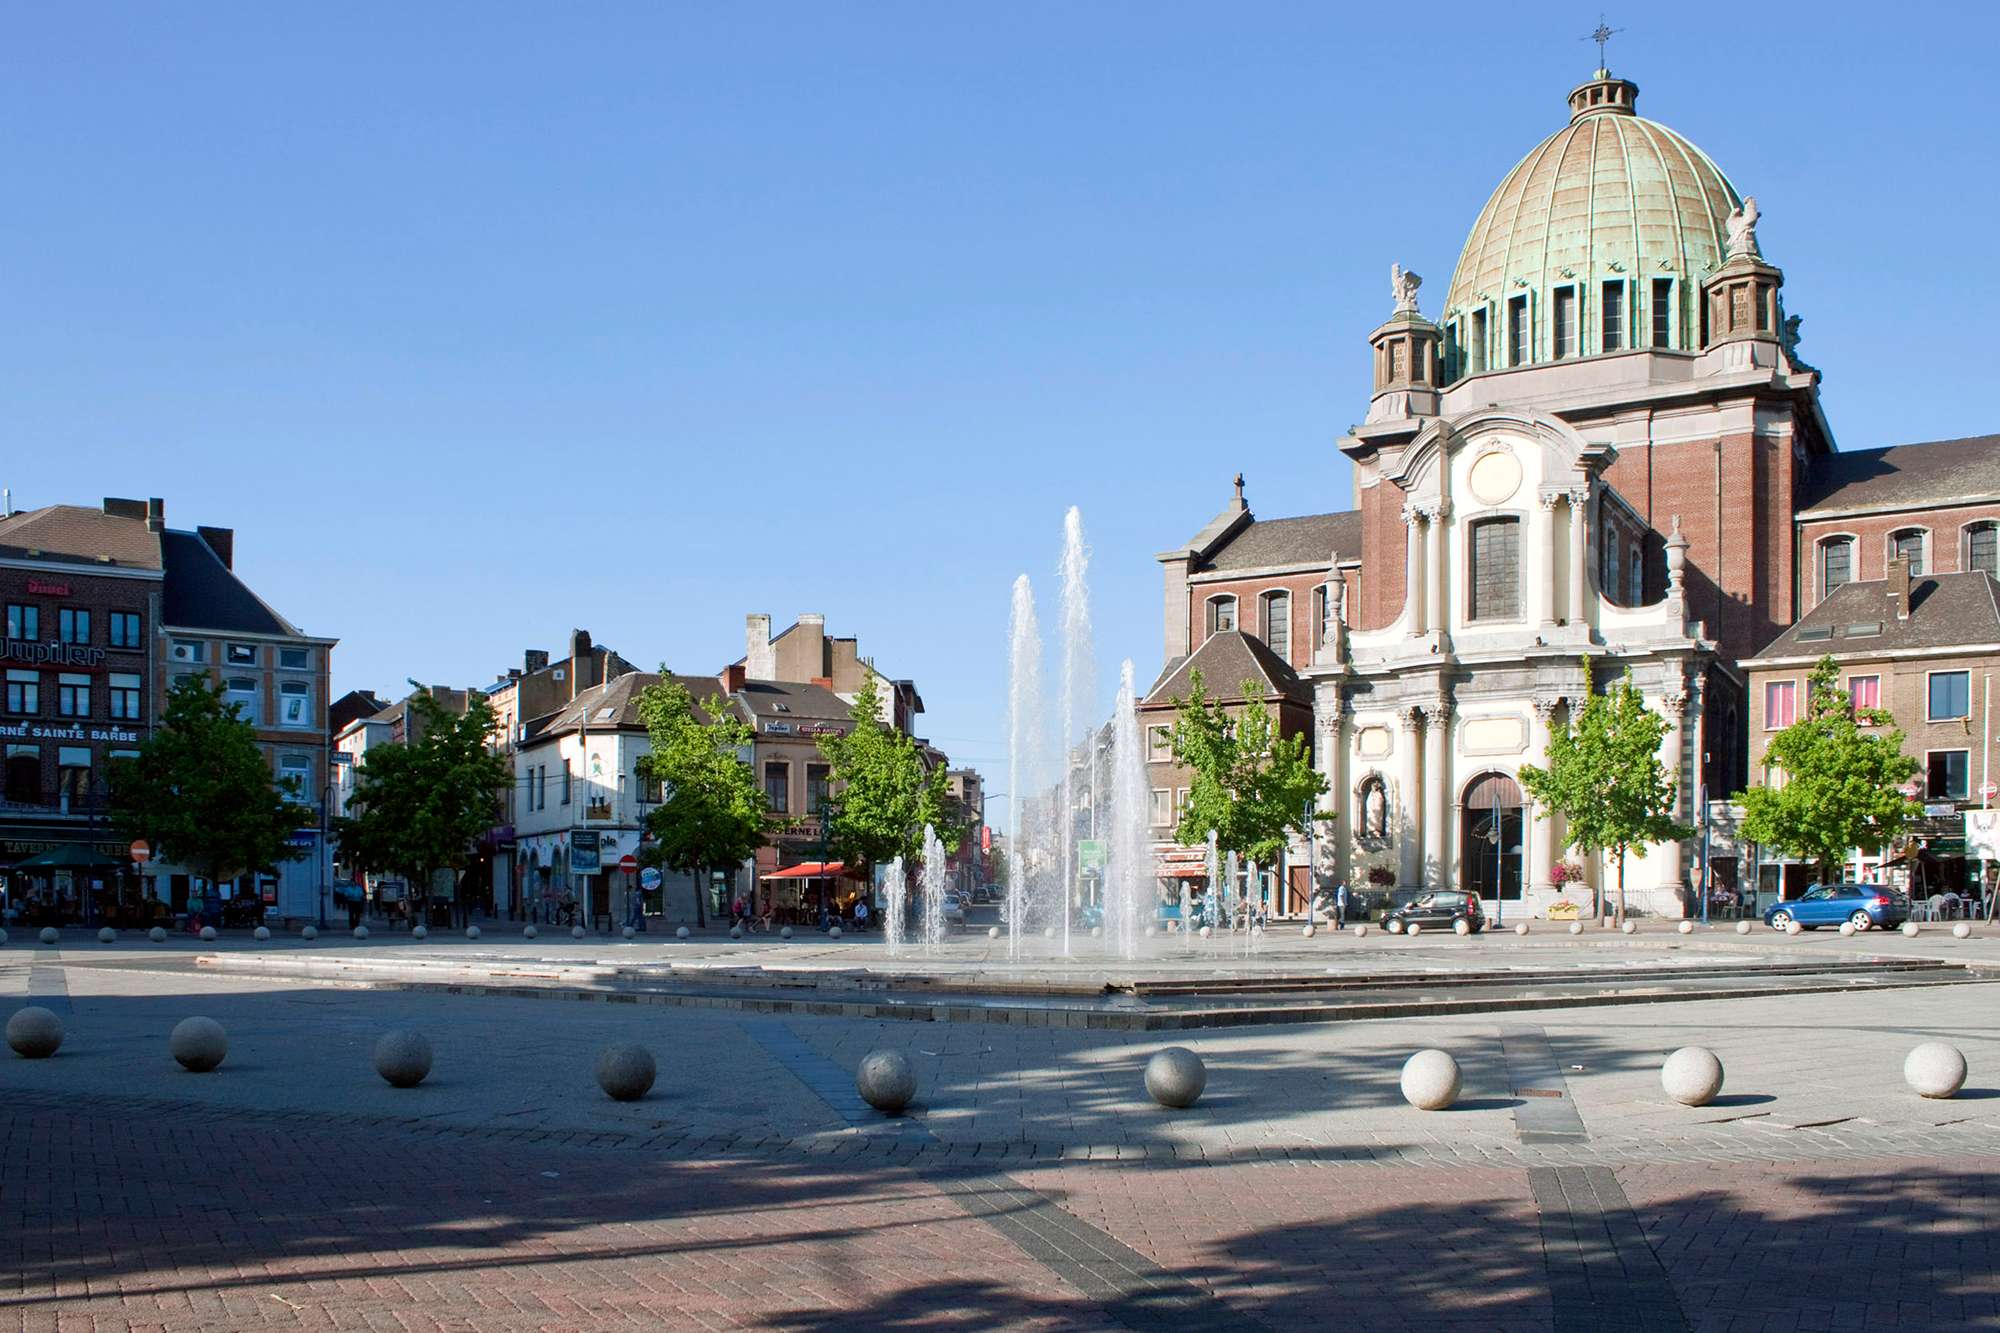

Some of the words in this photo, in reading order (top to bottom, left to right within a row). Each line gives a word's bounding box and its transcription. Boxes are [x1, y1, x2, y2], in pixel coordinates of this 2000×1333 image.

[0, 637, 105, 666] Jupiler
[32, 728, 85, 739] SAINTE
[91, 730, 137, 741] BARBE
